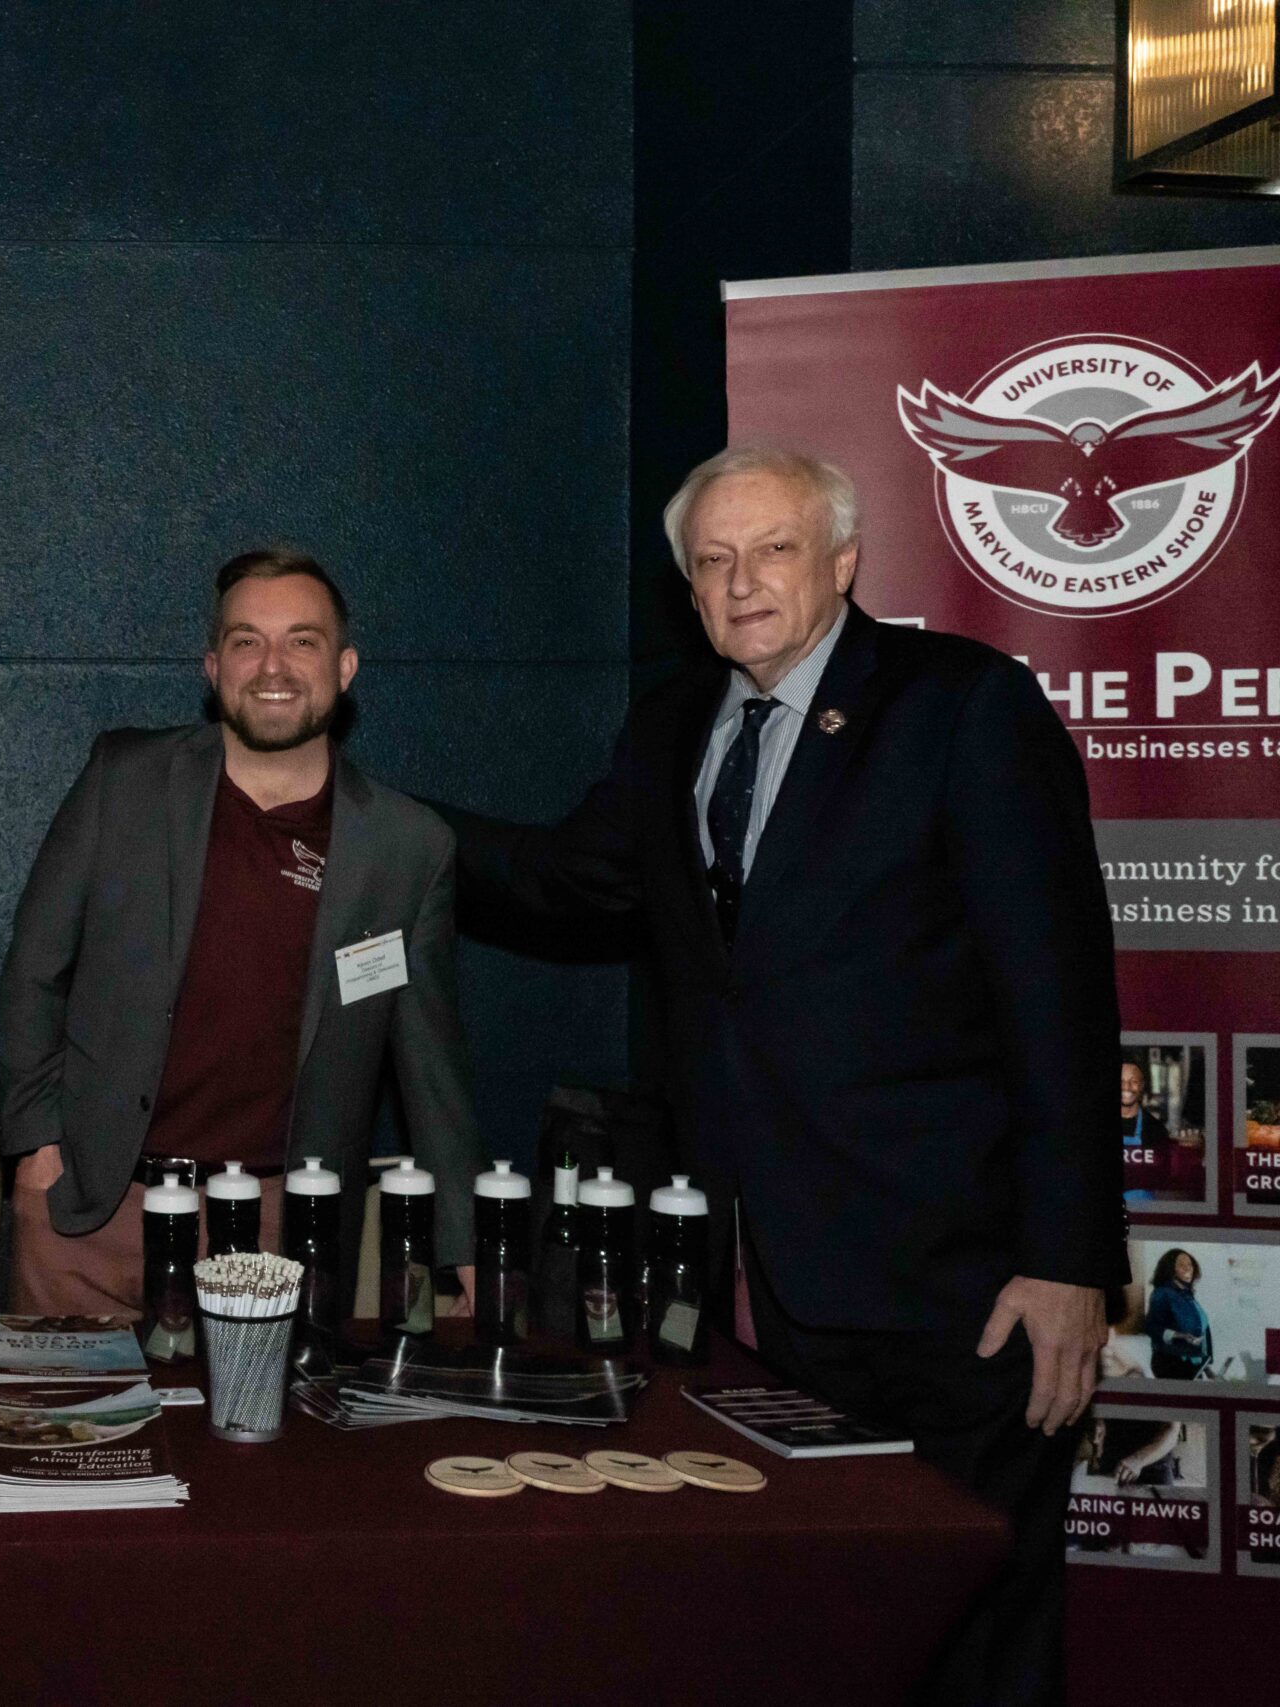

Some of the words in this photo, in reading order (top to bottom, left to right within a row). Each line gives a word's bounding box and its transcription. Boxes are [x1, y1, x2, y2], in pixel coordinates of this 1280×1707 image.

[1002, 357, 1139, 402] UNIVERSITY
[1142, 370, 1176, 393] OF
[1010, 502, 1050, 515] HBCU
[1130, 498, 1161, 511] 1886
[962, 500, 1058, 588] MARYLAND
[1063, 554, 1169, 593] EASTERN
[1165, 489, 1217, 559] SHORE
[1011, 655, 1129, 719] HE
[1086, 734, 1251, 759] businesses
[1260, 736, 1280, 758] t
[1242, 896, 1279, 923] in
[29, 1455, 84, 1464] Animal
[87, 1455, 137, 1464] Health
[49, 1447, 152, 1458] Transforming
[76, 1461, 152, 1470] Education
[1067, 1497, 1126, 1516] ARING
[1131, 1501, 1202, 1520] HAWKS
[1064, 1519, 1111, 1536] UDIO
